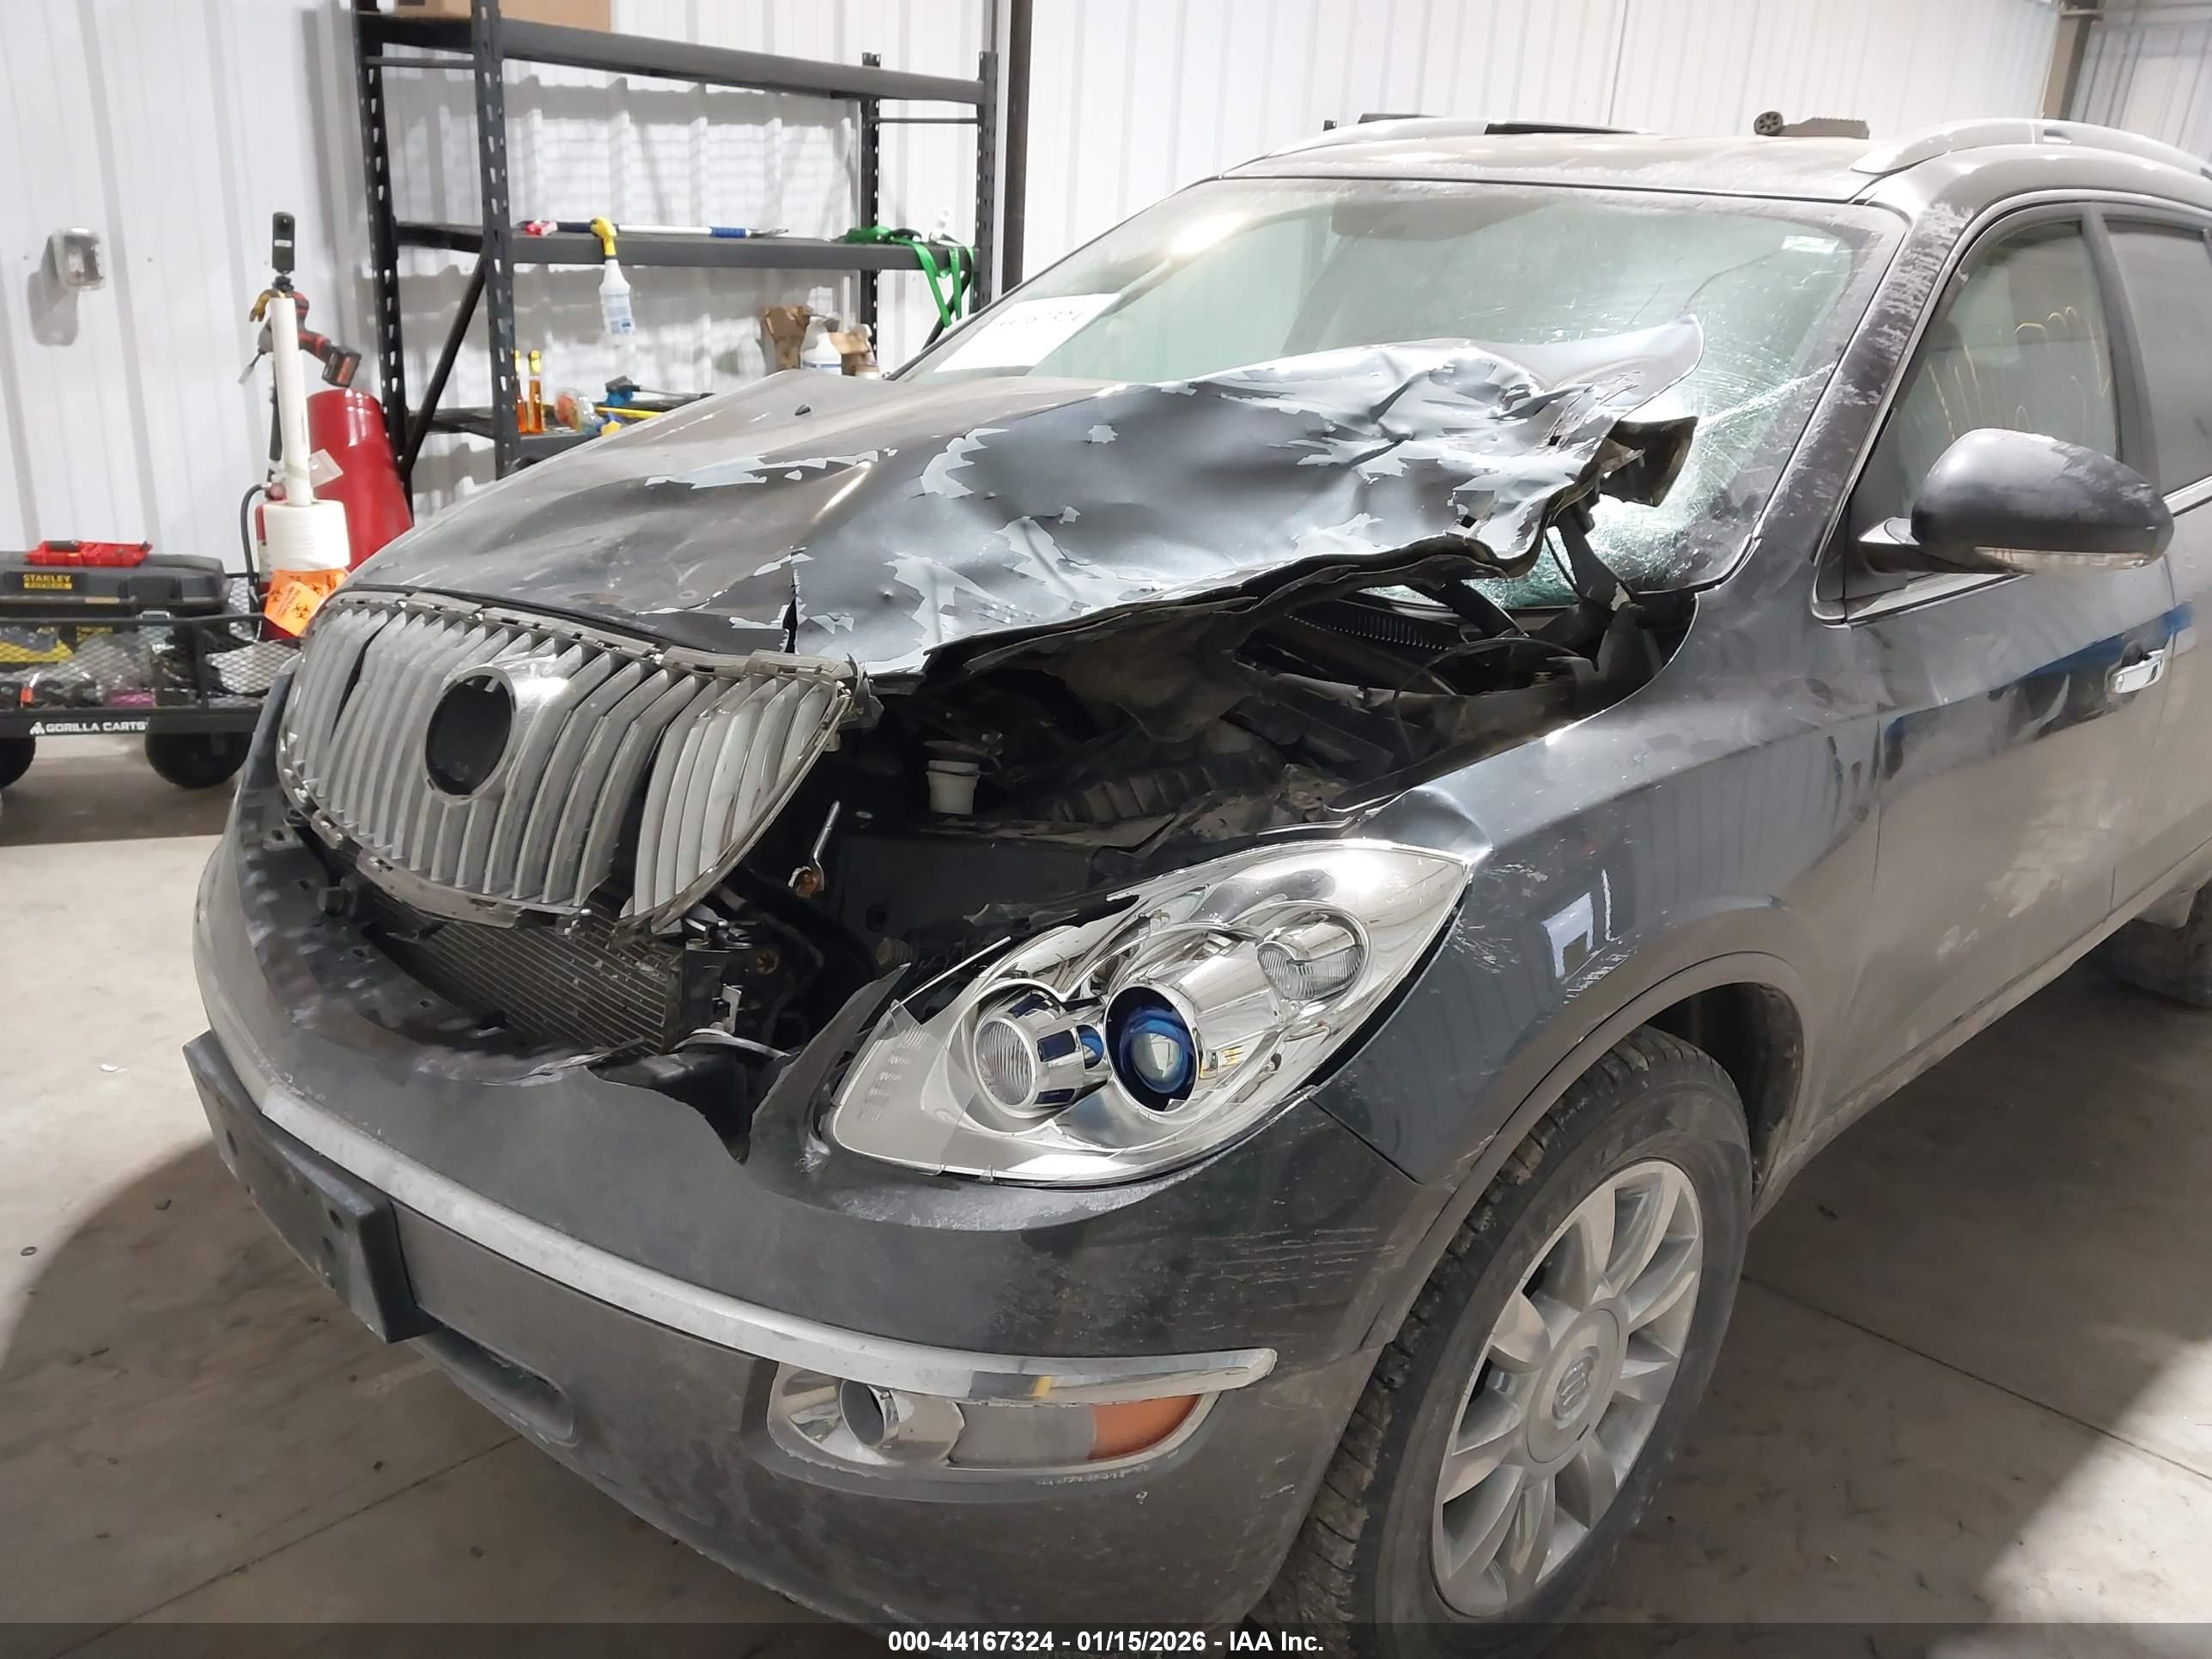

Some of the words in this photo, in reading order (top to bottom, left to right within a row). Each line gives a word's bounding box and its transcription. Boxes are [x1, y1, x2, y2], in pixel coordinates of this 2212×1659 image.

[23, 574, 71, 584] STANLEY
[46, 722, 100, 733] GORILLA
[102, 721, 146, 731] CARTS
